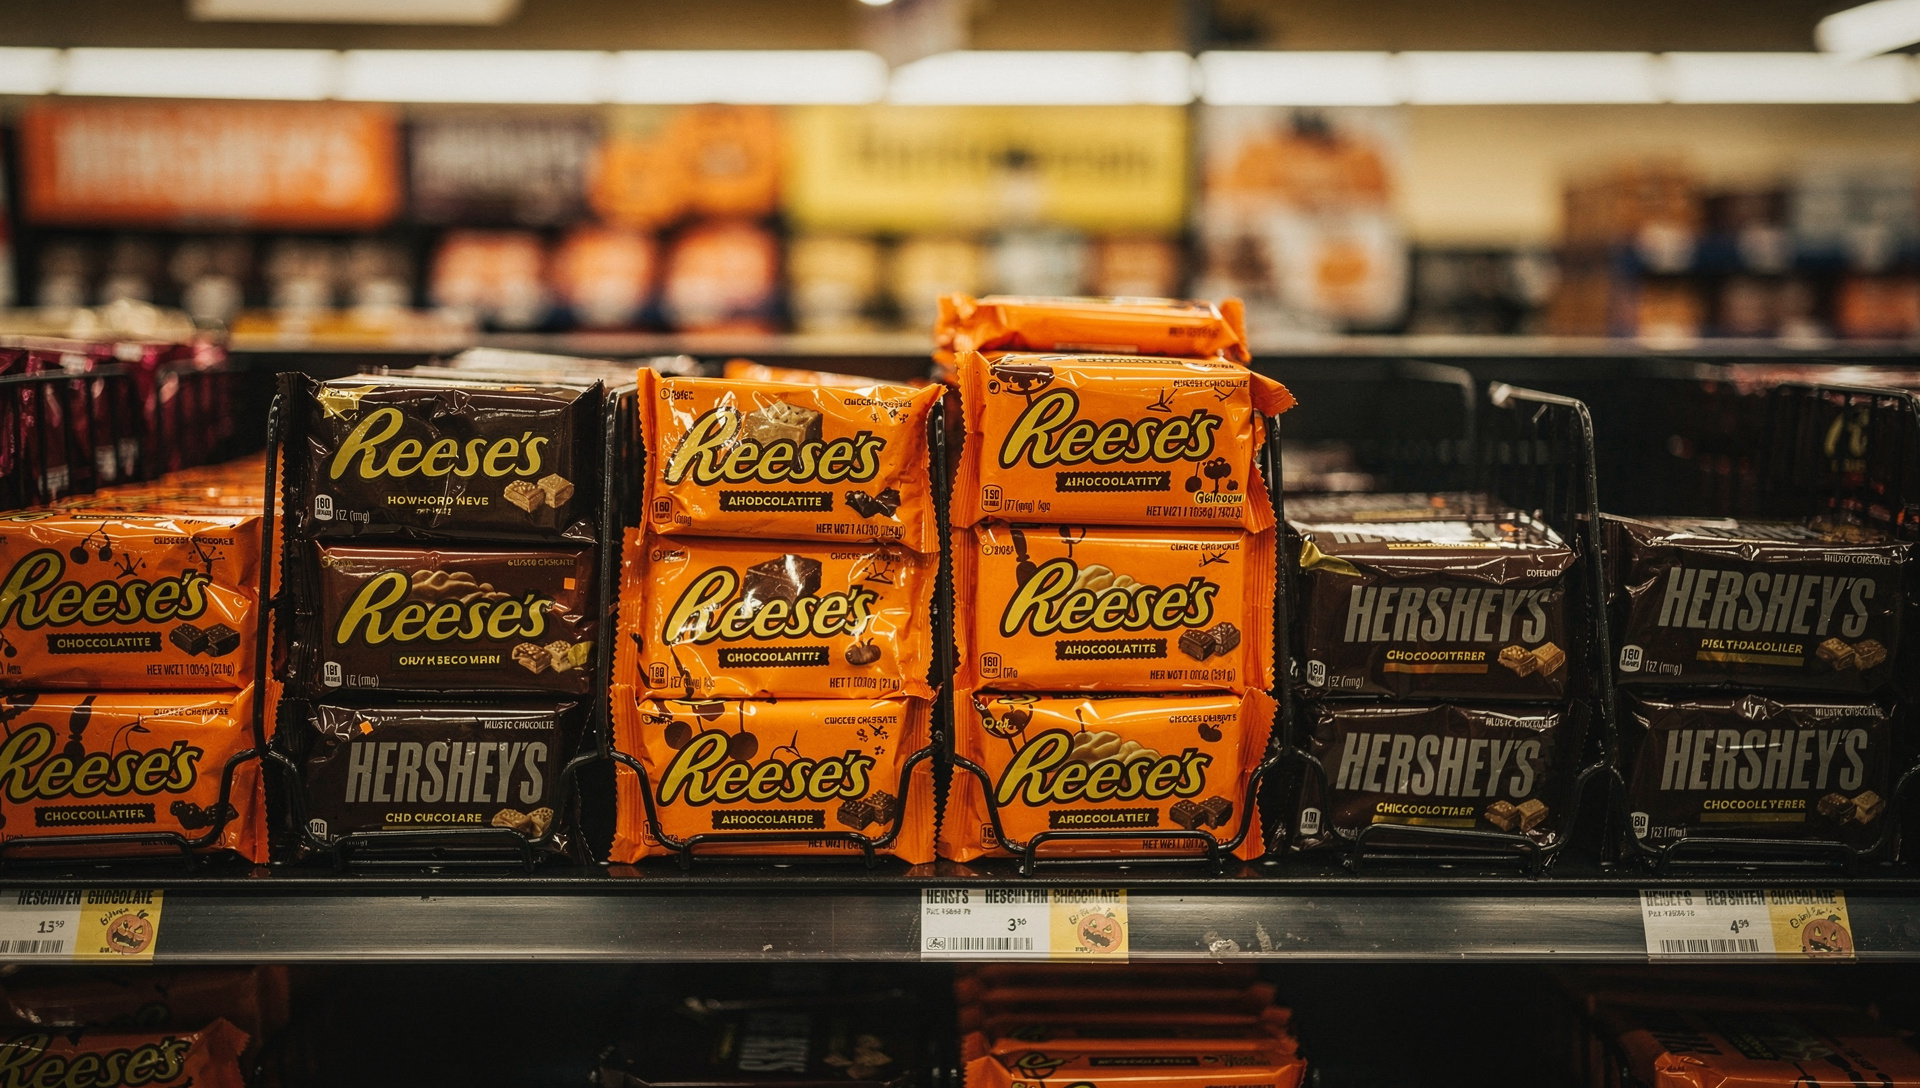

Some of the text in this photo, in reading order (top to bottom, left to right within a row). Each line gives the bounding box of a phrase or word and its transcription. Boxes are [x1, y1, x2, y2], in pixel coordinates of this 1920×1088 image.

[329, 407, 549, 480] Reese's
[667, 407, 882, 483] Reese's
[1003, 390, 1220, 465] Reese's
[0, 552, 209, 628] Reese's
[336, 571, 555, 644] Reese's
[664, 569, 876, 644] Reese's
[1004, 560, 1217, 634] Reese's
[1344, 585, 1553, 643] HERSHEY'S
[1657, 566, 1877, 638] HERSHEY'S
[0, 726, 200, 801] Reese's
[345, 741, 548, 805] HERSHEY'S
[661, 732, 871, 804] Reese's
[998, 731, 1208, 804] Reese's
[1335, 732, 1541, 799] HERSHEY'S
[1660, 728, 1869, 791] HERSHEY'S
[87, 889, 154, 905] CHOCOLATE
